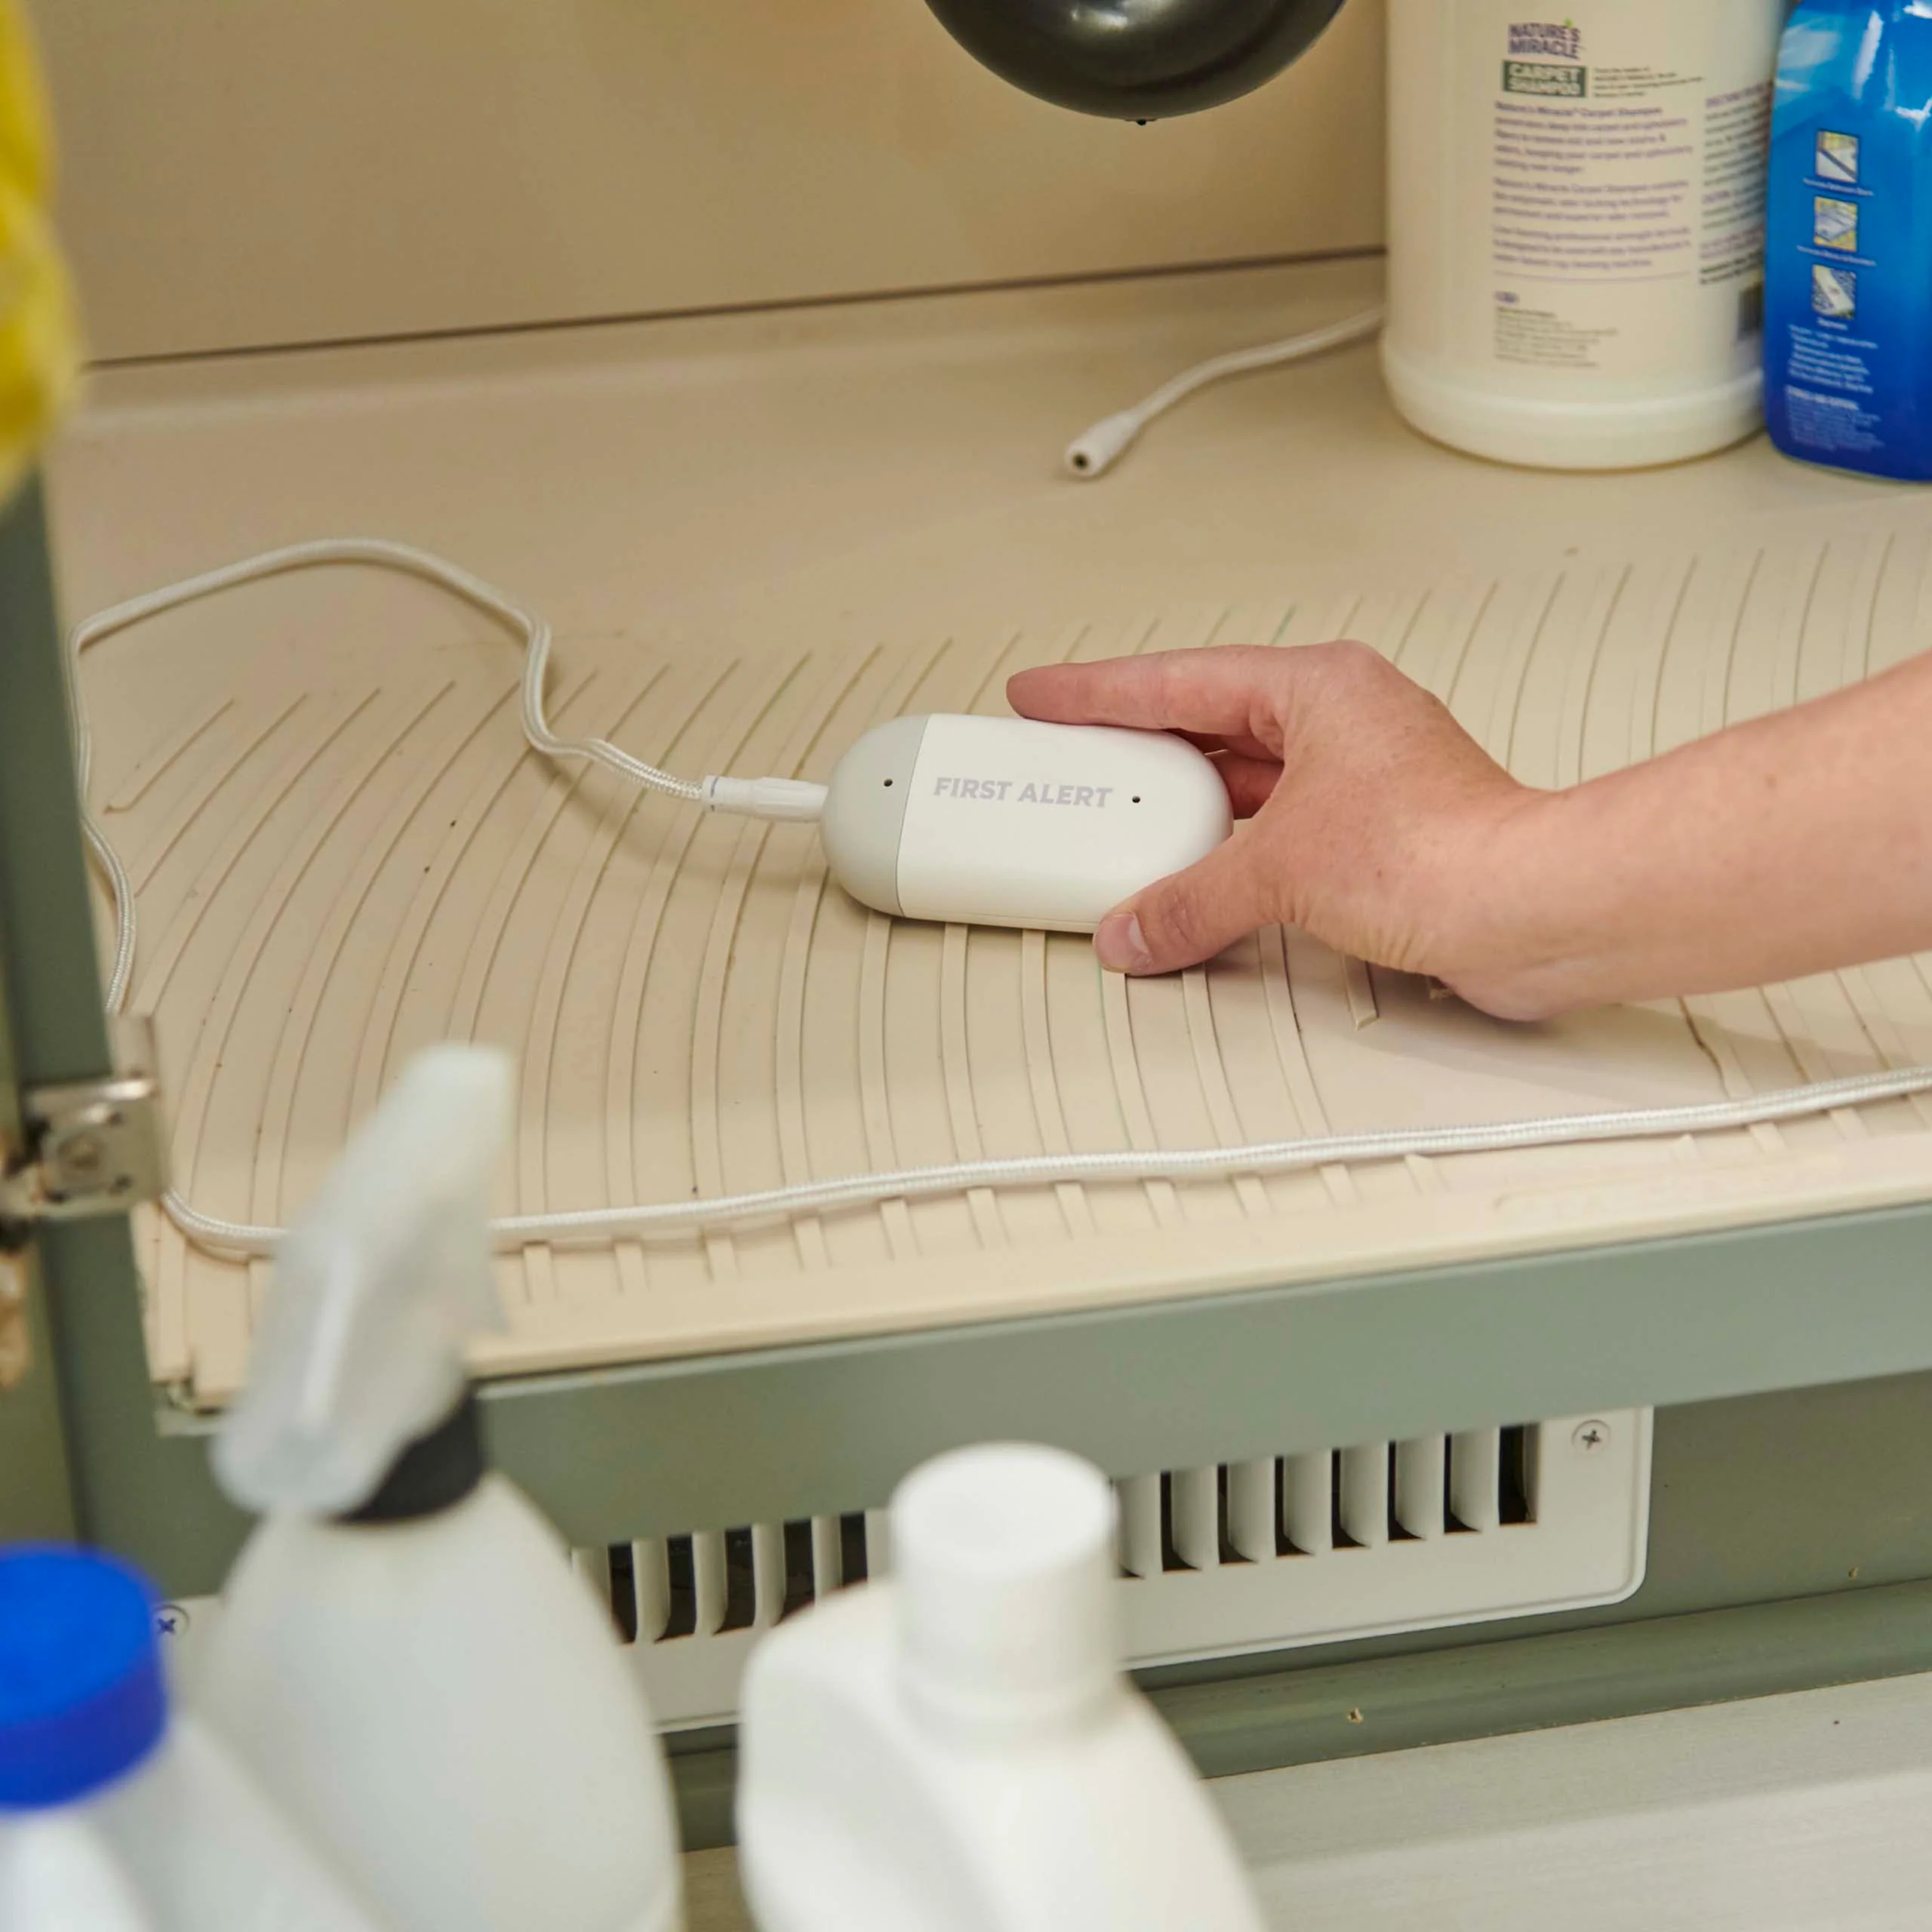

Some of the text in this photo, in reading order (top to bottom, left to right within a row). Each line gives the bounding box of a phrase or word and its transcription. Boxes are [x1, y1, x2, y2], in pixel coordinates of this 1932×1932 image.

[1509, 38, 1580, 60] MIRACLE
[1509, 63, 1581, 82] CARPET
[1509, 77, 1581, 96] SHAMPOO
[933, 777, 1113, 808] FIRST ALERT
